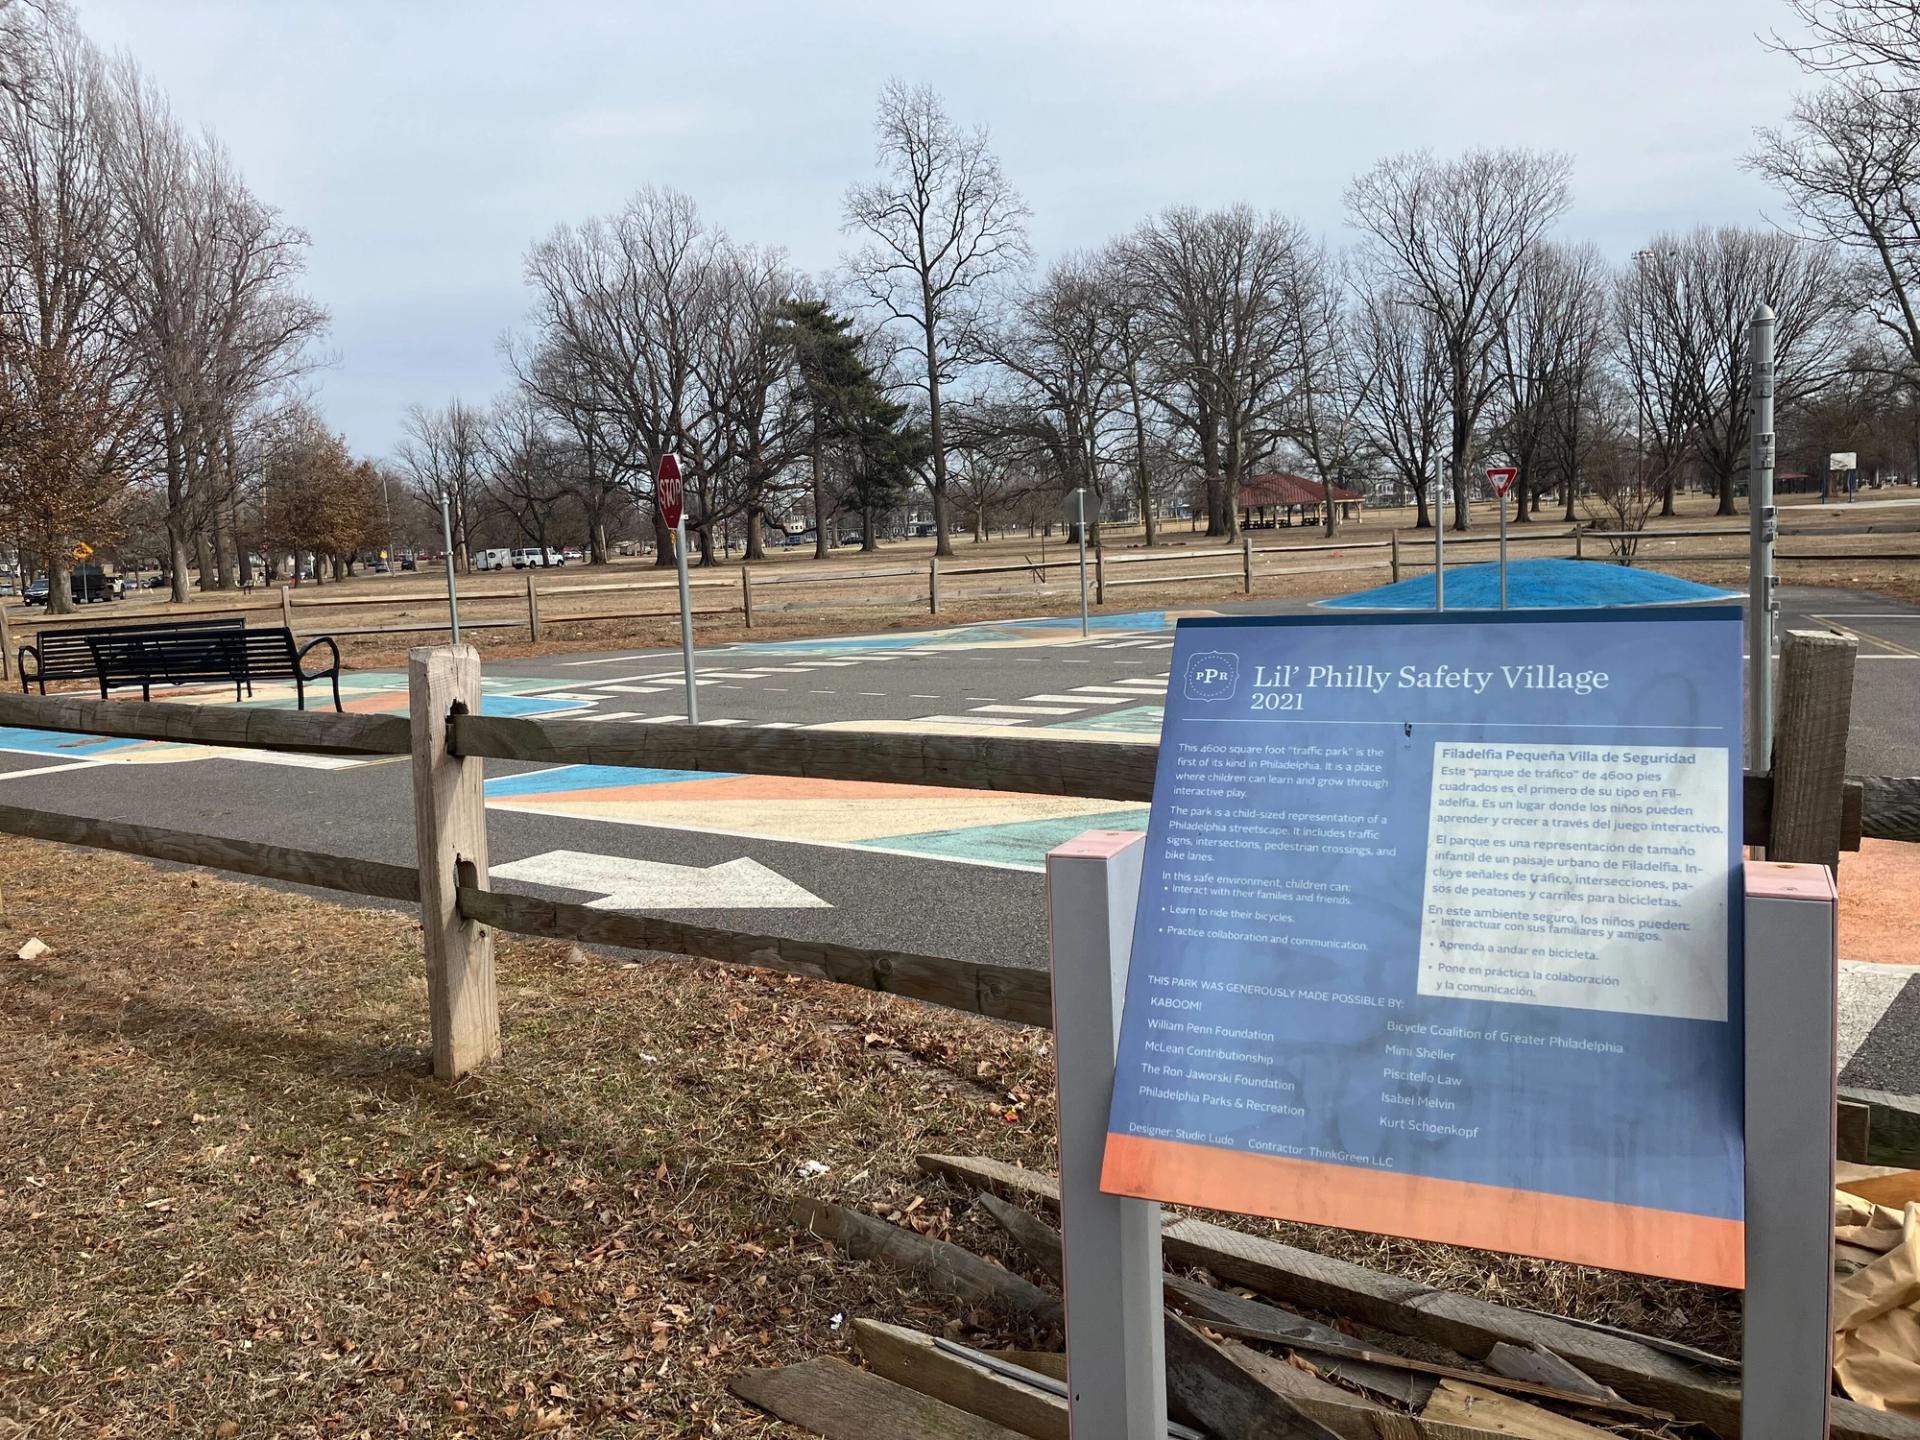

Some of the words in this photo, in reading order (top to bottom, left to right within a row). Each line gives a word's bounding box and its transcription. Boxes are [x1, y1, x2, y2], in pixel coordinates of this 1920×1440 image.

[660, 479, 681, 509] STOP
[1252, 665, 1299, 687] Lil’
[1305, 664, 1392, 693] Philly
[1397, 664, 1494, 694] Safety
[1498, 664, 1609, 695] Village
[1249, 692, 1305, 710] 2021
[1177, 743, 1197, 752] This
[1199, 744, 1226, 755] 4600
[1228, 746, 1262, 755] square
[1264, 745, 1286, 754] foot
[1355, 747, 1363, 756] is
[1366, 747, 1384, 757] the
[1441, 748, 1502, 760] Filadelfia
[1505, 749, 1565, 763] Pequeña
[1568, 750, 1598, 762] Villa
[1601, 751, 1618, 762] de
[1622, 752, 1695, 765] Seguridad
[1175, 771, 1205, 781] where
[1207, 772, 1246, 782] children
[1268, 774, 1293, 784] learn
[1295, 775, 1315, 784] and
[1317, 778, 1343, 787] grow
[1346, 776, 1389, 789] through
[1440, 766, 1466, 776] Este
[1516, 767, 1531, 778] de
[1582, 769, 1597, 779] de
[1600, 770, 1632, 782] 4600
[1636, 771, 1661, 783] pies
[1173, 785, 1224, 796] interactive
[1438, 782, 1498, 793] cuadrados
[1516, 784, 1527, 794] el
[1530, 784, 1577, 796] primero
[1580, 785, 1595, 796] de
[1615, 786, 1639, 799] tipo
[1642, 790, 1657, 798] en
[1482, 798, 1496, 808] Es
[1498, 801, 1513, 809] un
[1516, 799, 1545, 812] lugar
[1548, 800, 1586, 812] donde
[1590, 802, 1607, 812] los
[1610, 803, 1642, 814] niños
[1646, 805, 1693, 817] pueden
[1168, 820, 1226, 833] Philadelphia
[1292, 826, 1301, 835] It
[1302, 826, 1345, 837] includes
[1348, 828, 1379, 839] traffic
[1164, 849, 1185, 860] bike
[1263, 840, 1319, 852] pedestrian
[1376, 846, 1396, 856] and
[1434, 850, 1474, 862] infantil
[1477, 852, 1492, 863] de
[1494, 855, 1509, 864] un
[1512, 854, 1553, 868] paisaje
[1557, 856, 1600, 868] urbano
[1603, 858, 1618, 869] de
[1432, 866, 1462, 879] cluye
[1465, 868, 1508, 880] señales
[1511, 870, 1527, 881] de
[1432, 885, 1452, 893] sos
[1454, 883, 1469, 894] de
[1471, 885, 1525, 898] peatones
[1528, 890, 1536, 901] y
[1539, 889, 1584, 901] carriles
[1587, 894, 1615, 904] para
[1169, 904, 1196, 915] Learn
[1197, 906, 1208, 916] to
[1209, 907, 1228, 917] ride
[1230, 908, 1252, 919] their
[1166, 924, 1205, 937] Practice
[1206, 928, 1268, 942] collaboration
[1270, 933, 1288, 944] and
[1438, 938, 1485, 952] Aprenda
[1487, 944, 1494, 952] a
[1496, 943, 1528, 955] andar
[1531, 947, 1545, 956] en
[1438, 961, 1465, 973] Pone
[1468, 966, 1482, 975] en
[1484, 965, 1529, 979] práctica
[1532, 968, 1542, 980] la
[1545, 970, 1619, 986] colaboración
[1147, 974, 1169, 985] THIS
[1171, 977, 1198, 988] PARK
[1199, 979, 1224, 991] WAS
[1225, 982, 1295, 998] GENEROUSLY
[1298, 989, 1329, 1001] MADE
[1331, 992, 1385, 1006] POSSIBLE
[1435, 980, 1442, 991] y
[1444, 978, 1454, 990] la
[1146, 1018, 1184, 1032] William
[1186, 1022, 1212, 1035] Penn
[1214, 1025, 1274, 1042] Foundation
[1386, 1020, 1426, 1035] Bicycle
[1429, 1024, 1481, 1040] Coalition
[1484, 1030, 1497, 1041] of
[1500, 1031, 1546, 1046] Greater
[1549, 1036, 1623, 1055] Philadelphia
[1144, 1040, 1184, 1055] McLean
[1186, 1045, 1273, 1068] Contributionship
[1384, 1043, 1412, 1057] Mimi
[1415, 1046, 1456, 1061] Sheller
[1139, 1062, 1160, 1075] The
[1162, 1065, 1183, 1077] Ron
[1185, 1068, 1232, 1083] Jaworski
[1234, 1073, 1295, 1091] Foundation
[1382, 1067, 1434, 1084] Piscitello
[1437, 1073, 1462, 1087] Law
[1138, 1085, 1200, 1103] Philadelphia
[1202, 1093, 1232, 1107] Parks
[1233, 1097, 1243, 1108] &
[1245, 1098, 1305, 1117] Recreation
[1381, 1091, 1415, 1106] Isabel
[1417, 1095, 1455, 1111] Melvin
[1174, 1127, 1206, 1142] Studio
[1208, 1132, 1234, 1146] Ludo
[1379, 1115, 1405, 1129] Kurt
[1408, 1119, 1478, 1141] Schoenkopf
[1308, 1145, 1369, 1164] ThinkGreen
[1371, 1154, 1393, 1168] LLC
